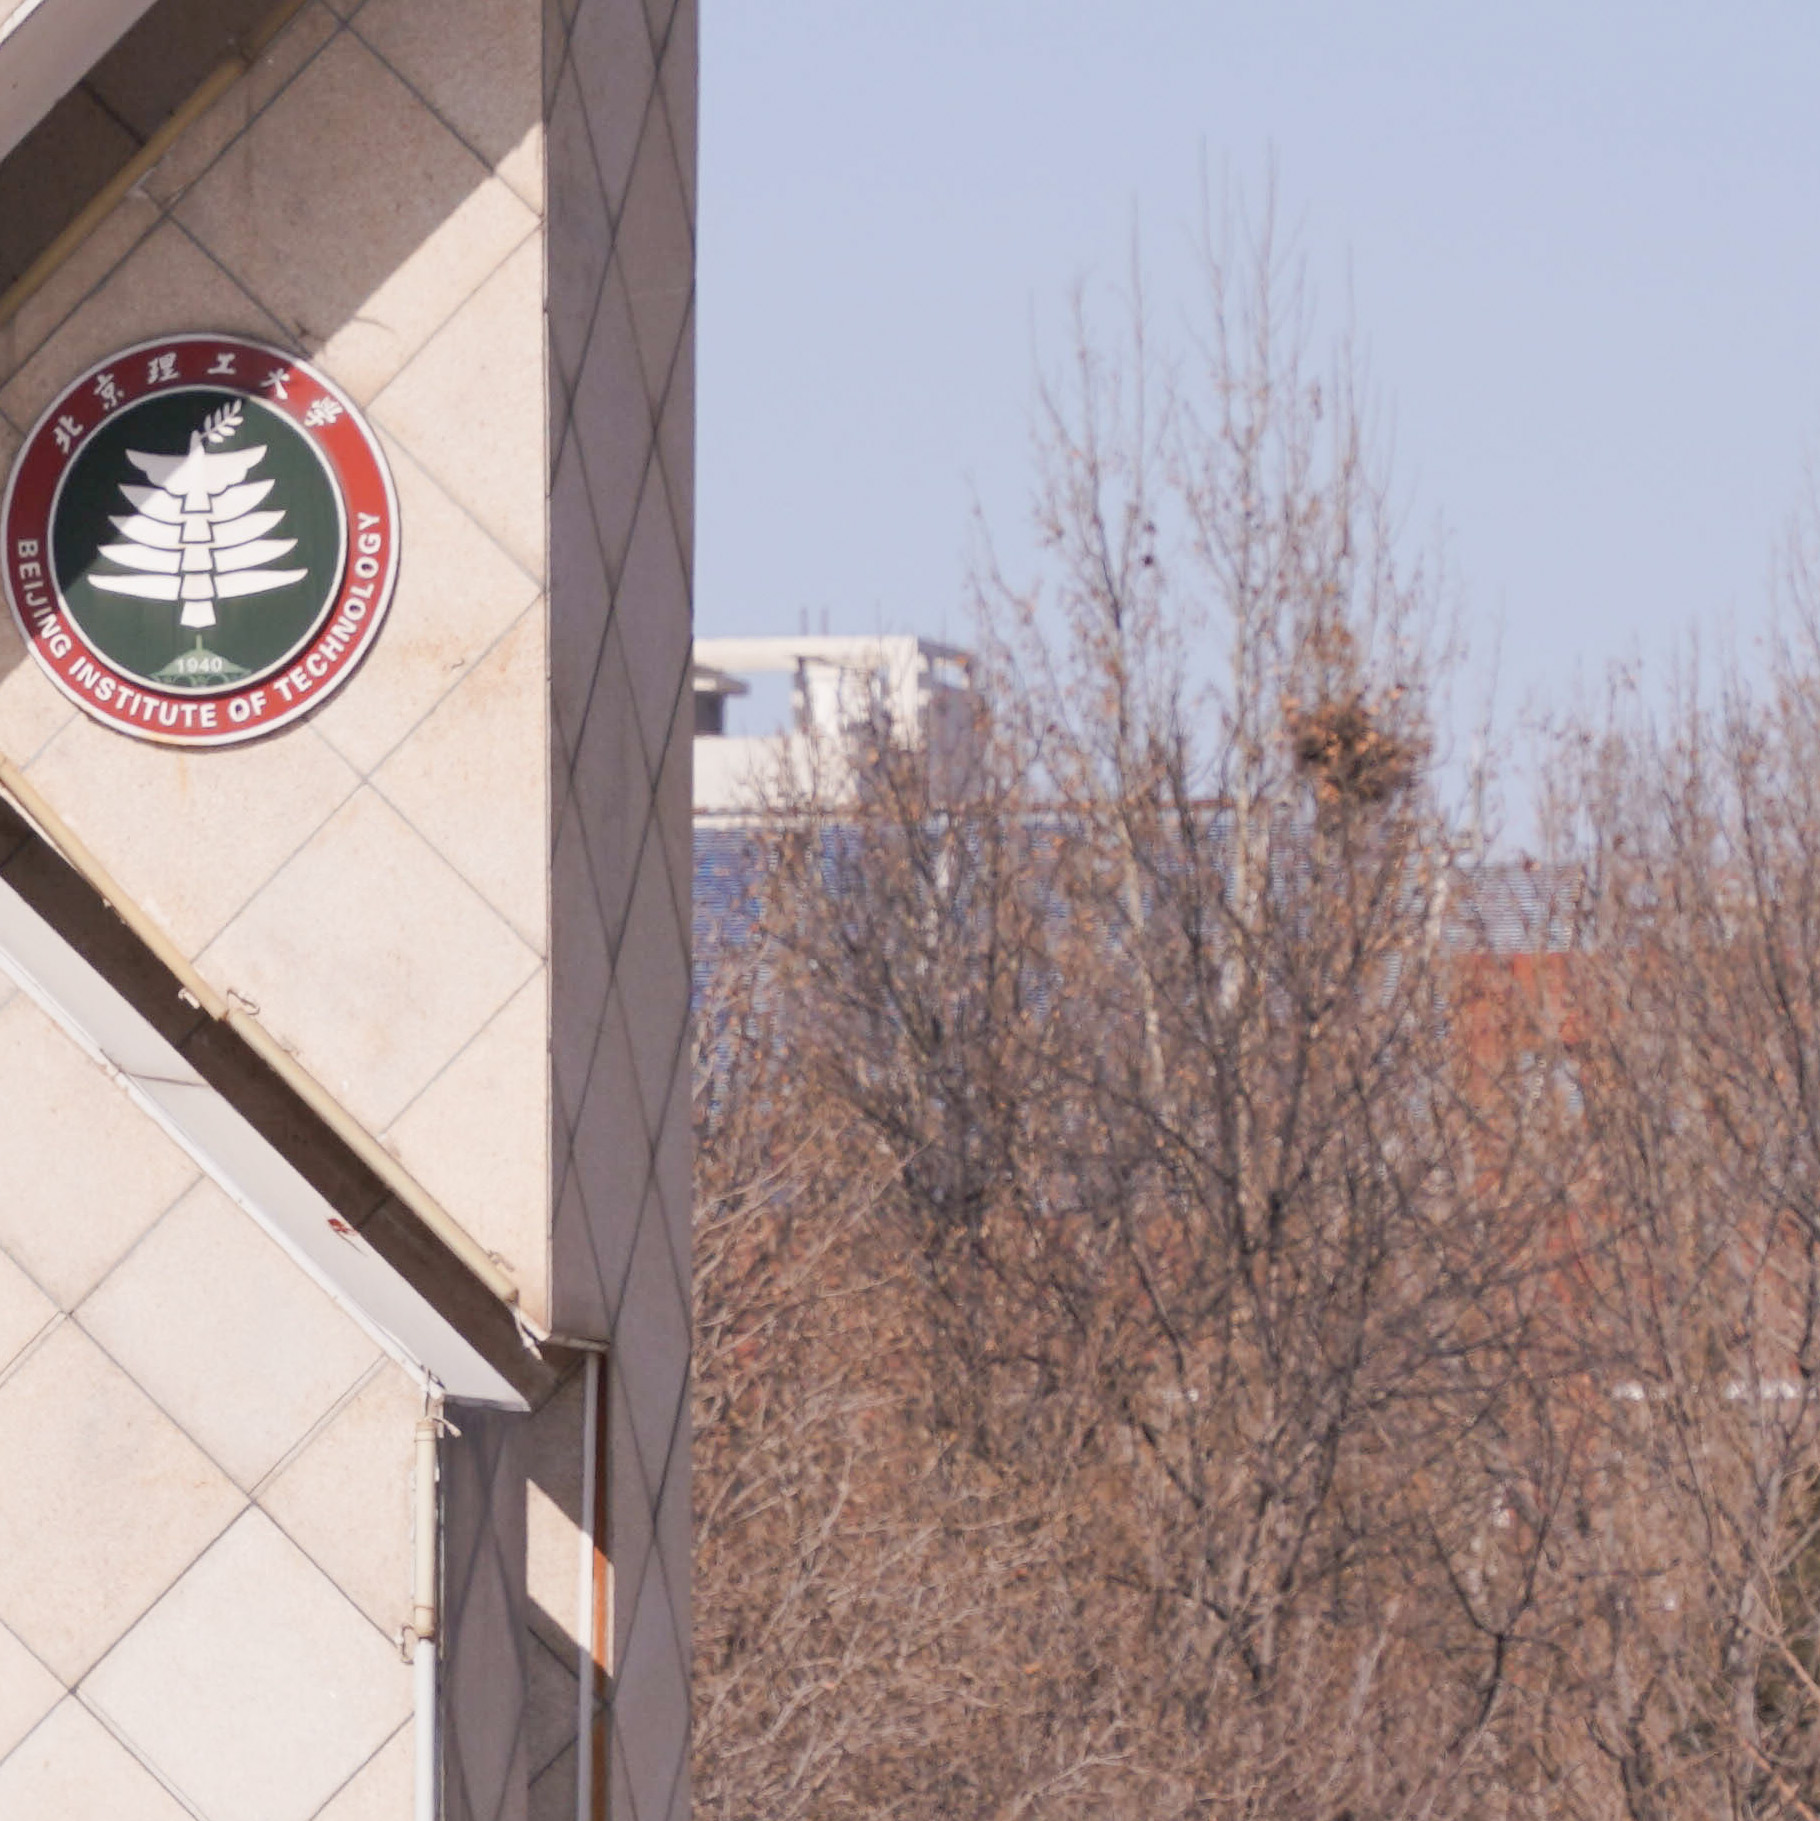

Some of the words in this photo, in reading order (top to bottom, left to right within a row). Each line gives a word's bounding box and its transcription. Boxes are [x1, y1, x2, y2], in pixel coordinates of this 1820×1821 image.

[17, 539, 72, 659] BEIJING
[68, 656, 217, 728] INSTITUTE
[227, 690, 267, 723] OF
[273, 512, 381, 701] TECHNOLOGY
[176, 658, 223, 674] 1940
